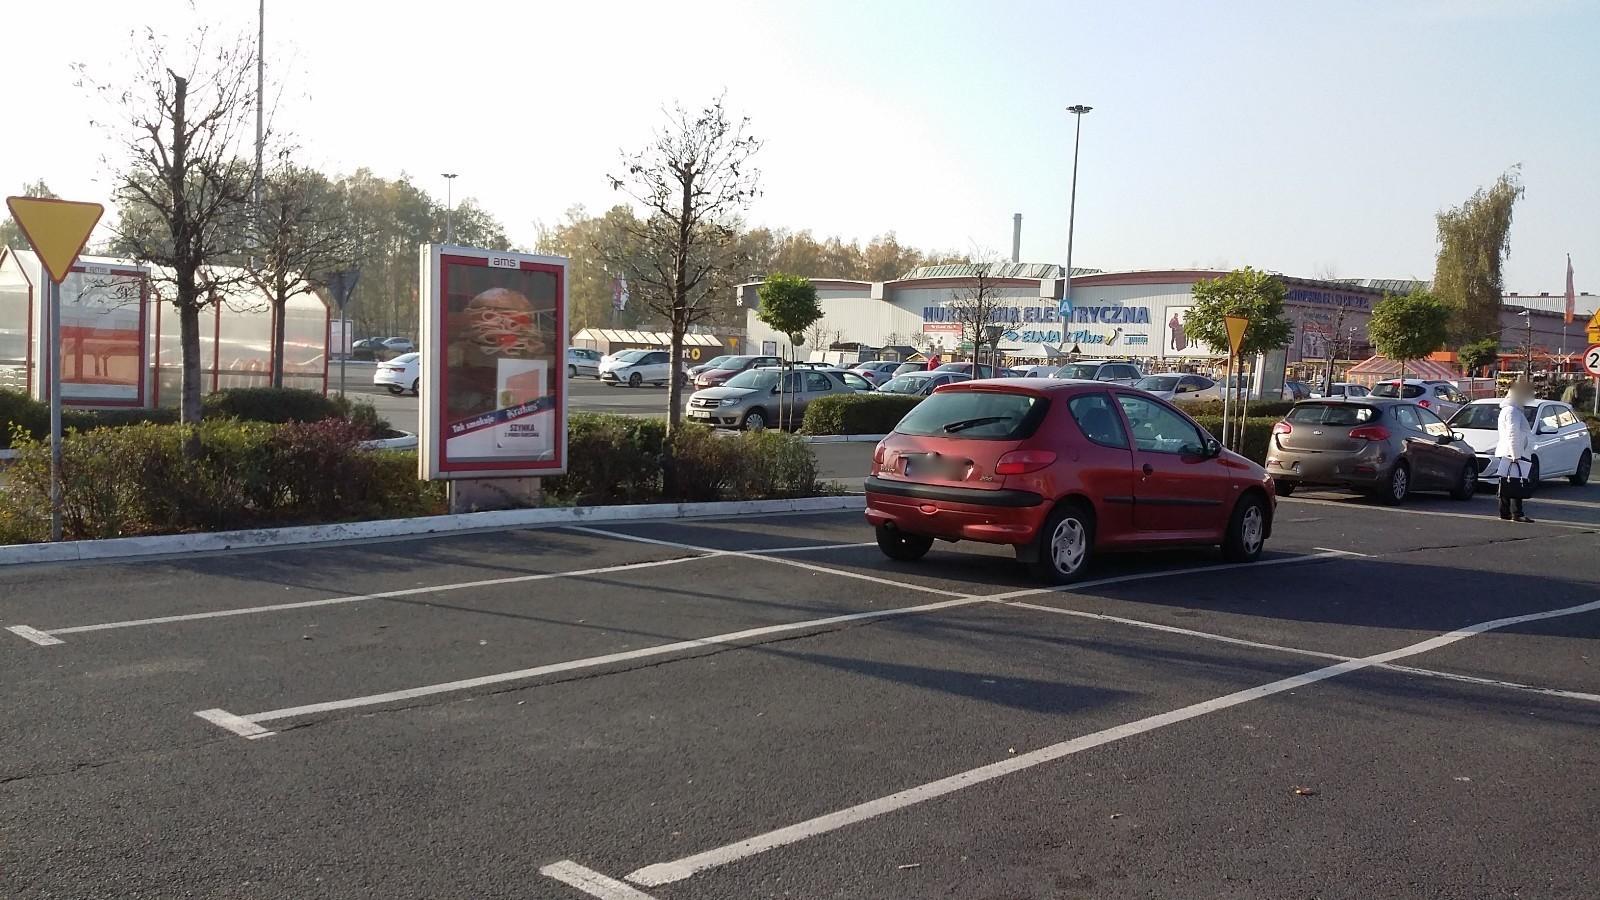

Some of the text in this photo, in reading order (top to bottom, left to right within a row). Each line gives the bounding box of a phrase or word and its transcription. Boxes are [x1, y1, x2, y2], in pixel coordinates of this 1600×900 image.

[493, 257, 516, 267] ams
[1061, 301, 1071, 312] A
[1023, 305, 1151, 324] ELETRYCZNA
[1073, 329, 1105, 344] Plus
[1588, 352, 1600, 369] 2
[510, 424, 535, 432] SZYNKA
